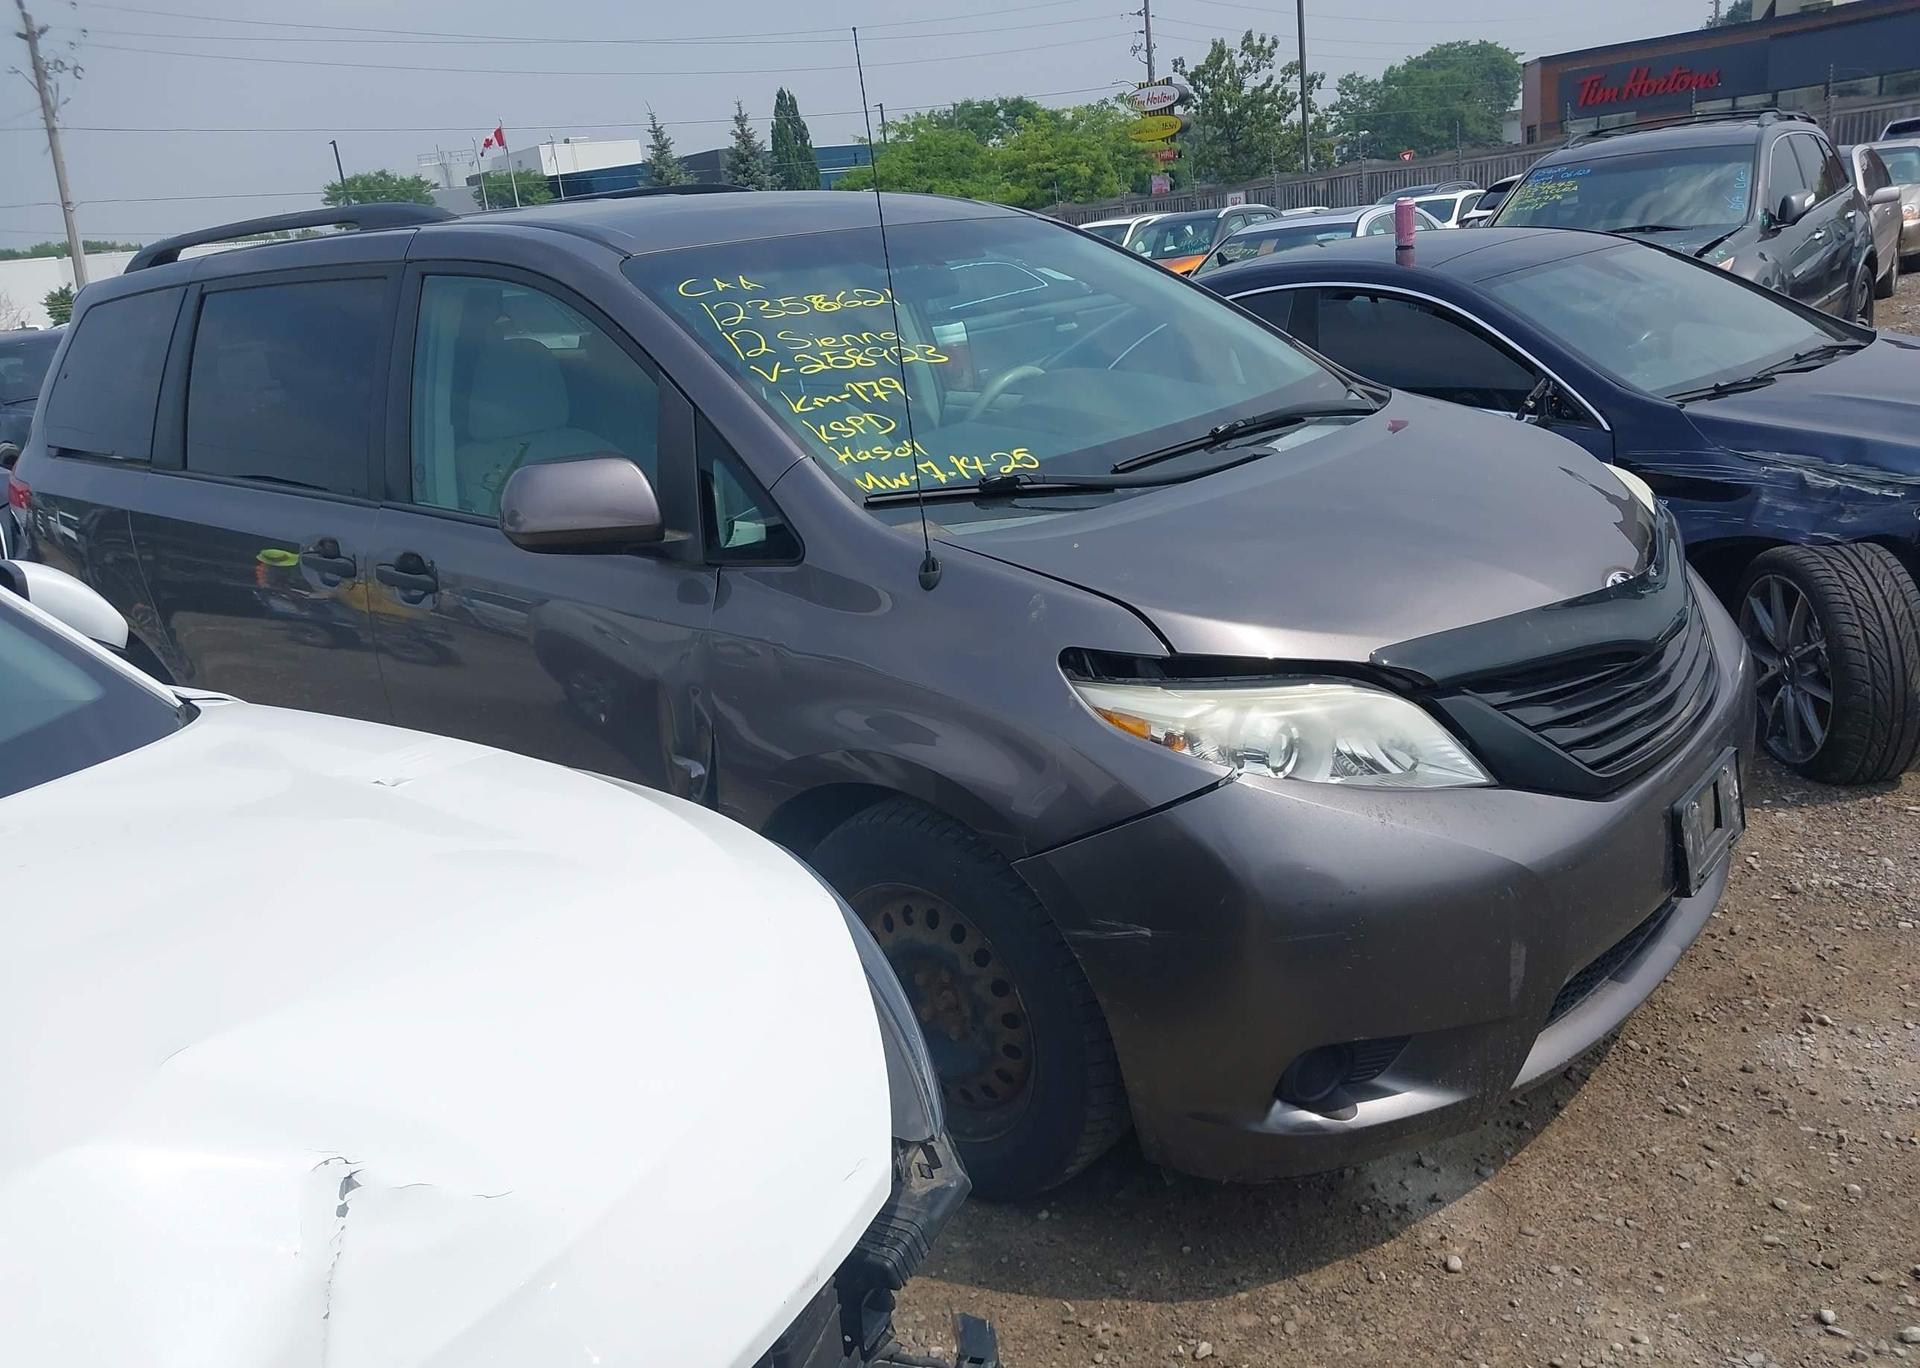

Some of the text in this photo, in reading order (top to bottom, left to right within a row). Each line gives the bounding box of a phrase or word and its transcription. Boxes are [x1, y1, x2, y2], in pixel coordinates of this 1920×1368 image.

[1578, 66, 1720, 107] Tim Hortons
[678, 275, 766, 297] CAA
[722, 329, 905, 361] 12 Sienna
